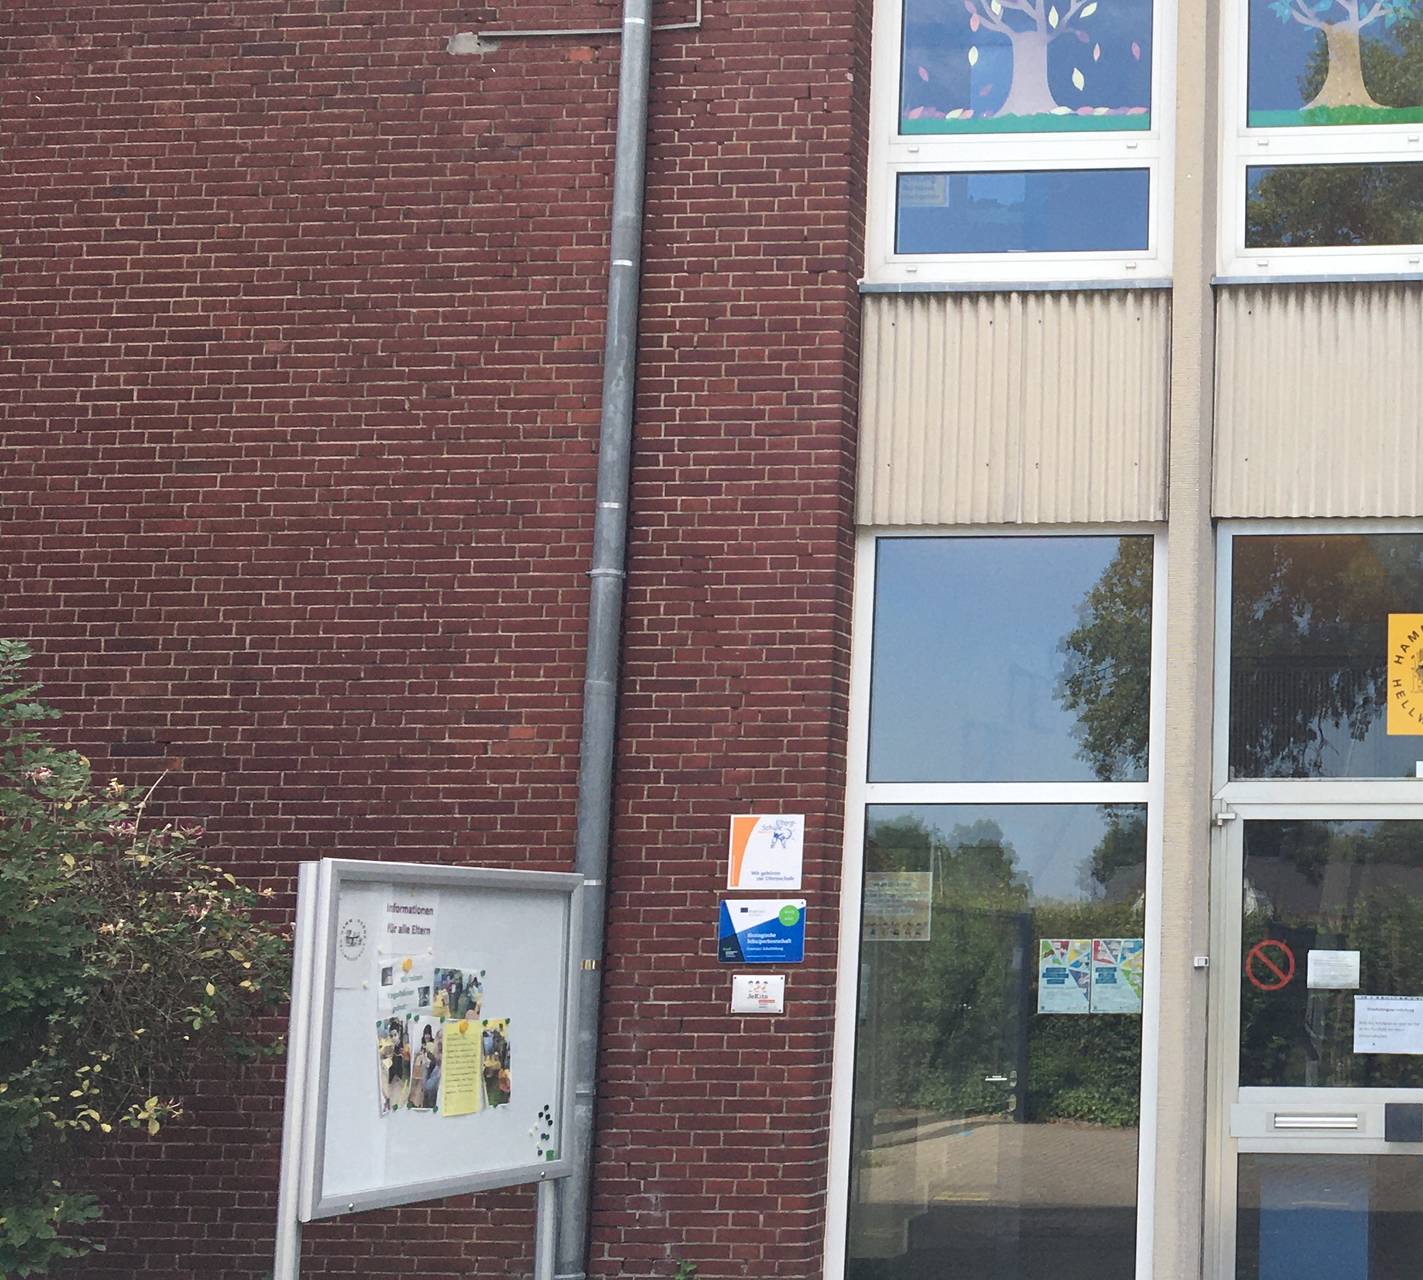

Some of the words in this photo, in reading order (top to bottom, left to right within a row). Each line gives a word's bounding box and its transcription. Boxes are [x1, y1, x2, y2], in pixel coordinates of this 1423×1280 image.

[386, 902, 434, 915] Informationen
[386, 922, 397, 934] für
[398, 924, 410, 934] alle
[411, 924, 431, 935] Eltern
